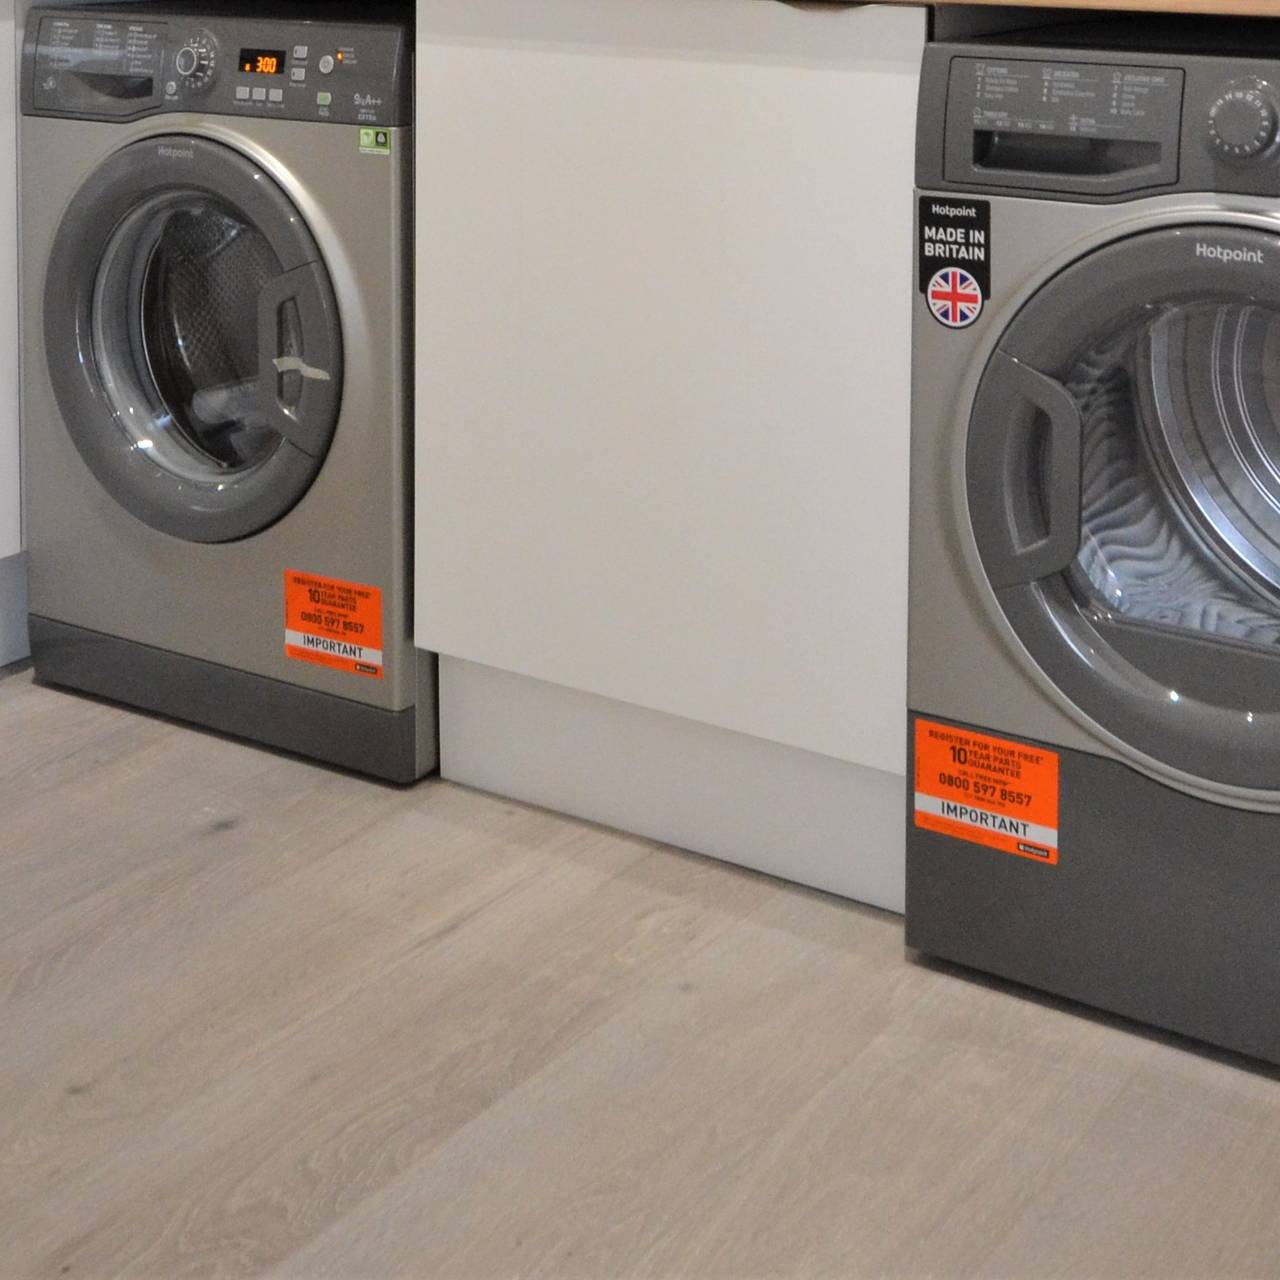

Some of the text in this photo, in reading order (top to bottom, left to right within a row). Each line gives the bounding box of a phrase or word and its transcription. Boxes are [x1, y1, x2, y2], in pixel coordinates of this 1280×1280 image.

[256, 56, 277, 72] 300
[932, 204, 976, 218] Hotpoint
[924, 226, 985, 244] MADE IN
[924, 242, 985, 261] BRITAIN
[1196, 242, 1264, 264] Hotpoint
[308, 588, 320, 604] 10
[303, 635, 364, 658] IMPORTANT
[928, 730, 970, 746] REGISTER
[973, 740, 990, 752] FOR
[992, 745, 1016, 758] YOUR
[950, 745, 968, 764] 10
[968, 750, 1022, 770] YEAR PARTS
[968, 758, 1022, 779] GUARANTEE
[939, 772, 970, 792] 0800
[974, 780, 996, 798] 597
[1000, 788, 1032, 806] 8557
[941, 801, 1030, 837] IMPORTANT
